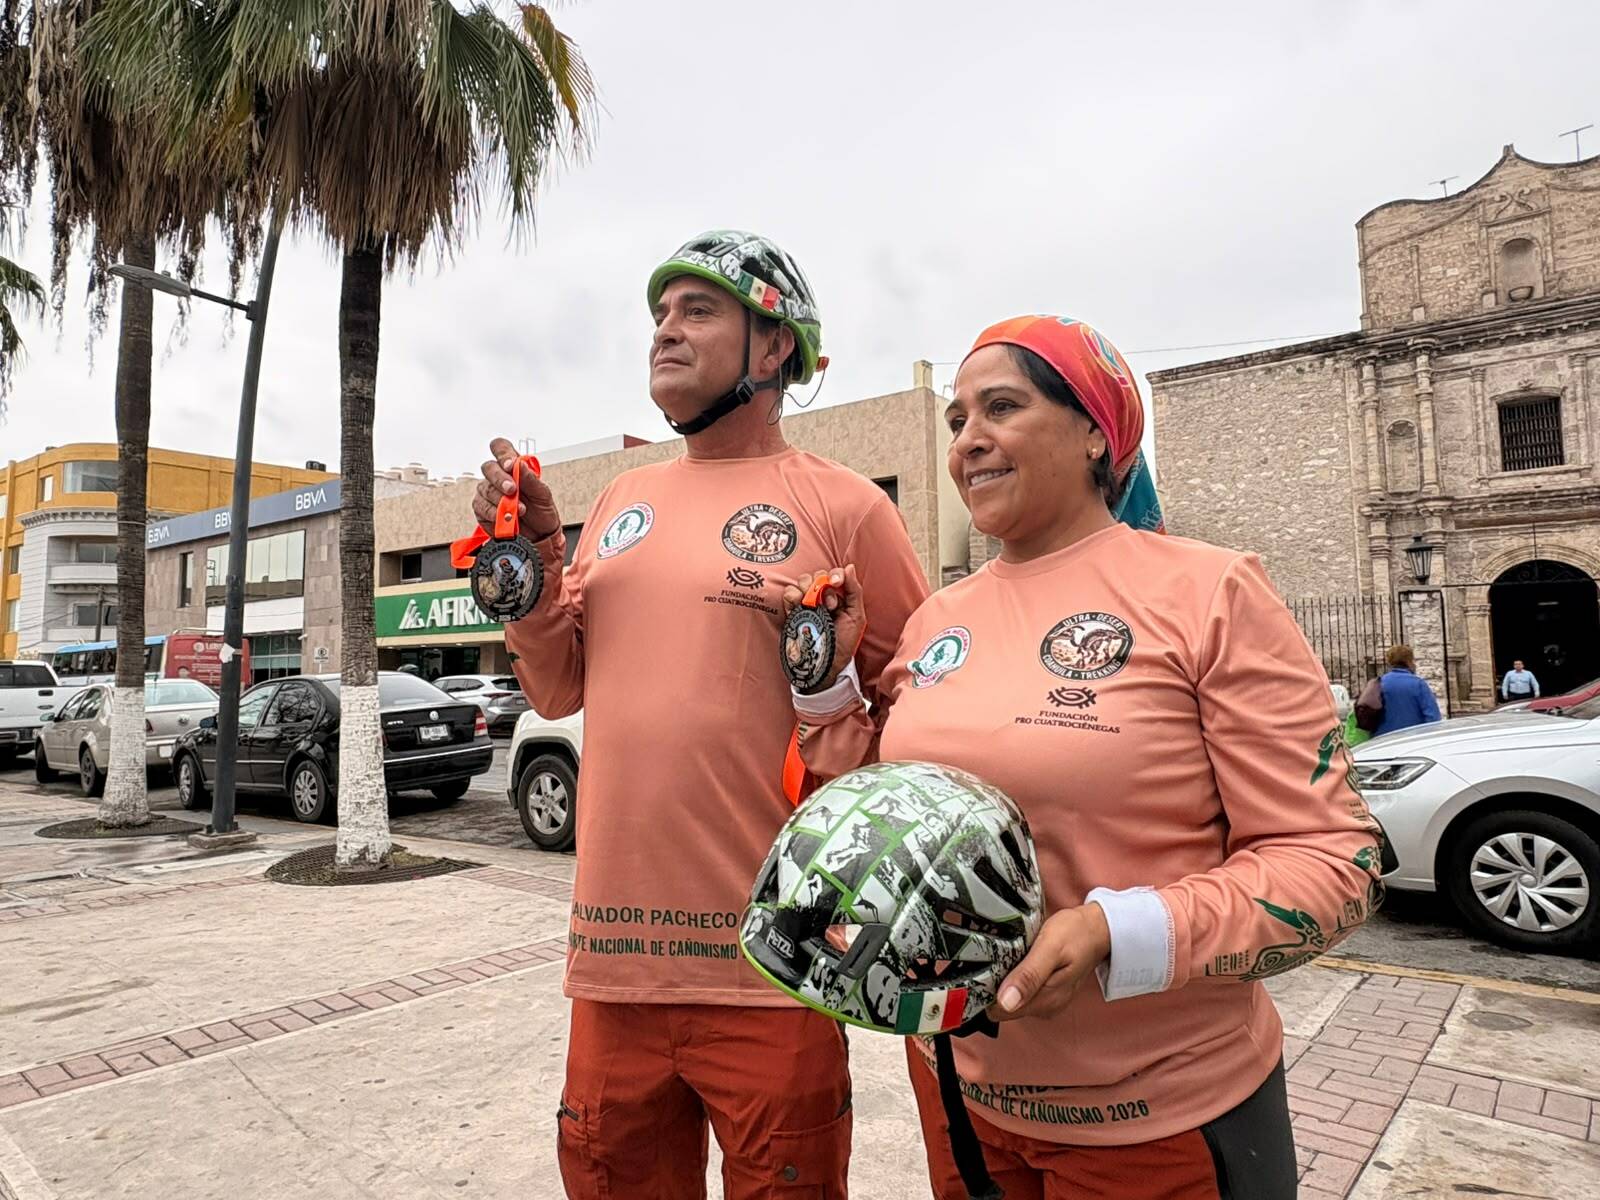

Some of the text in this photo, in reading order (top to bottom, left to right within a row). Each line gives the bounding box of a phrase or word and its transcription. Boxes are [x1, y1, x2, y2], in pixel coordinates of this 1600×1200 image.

[295, 488, 327, 511] BBVA
[214, 512, 232, 528] BBV
[742, 504, 793, 526] ULTRA DESERT
[148, 526, 170, 544] BBVA
[723, 537, 786, 563] COAHUILA TREKKING
[718, 597, 779, 615] CUATROCIÉNEGAS
[721, 589, 765, 603] FUNDACIÓN
[426, 595, 497, 628] AFIRM
[1062, 613, 1128, 631] ULTRA DESERT
[1042, 654, 1122, 680] COAHUILA TREKKING
[1015, 717, 1121, 734] PRO CUATROCIÉNEGAS
[1039, 710, 1098, 722] FUNDACIÓN
[651, 909, 737, 929] PACHECO
[590, 936, 647, 955] NACIONAL
[651, 940, 665, 956] DE
[669, 938, 738, 960] CAÑONISMO
[1001, 1096, 1018, 1117] DE
[1020, 1099, 1104, 1125] CAÑONISMO
[1107, 1099, 1150, 1122] 2026
